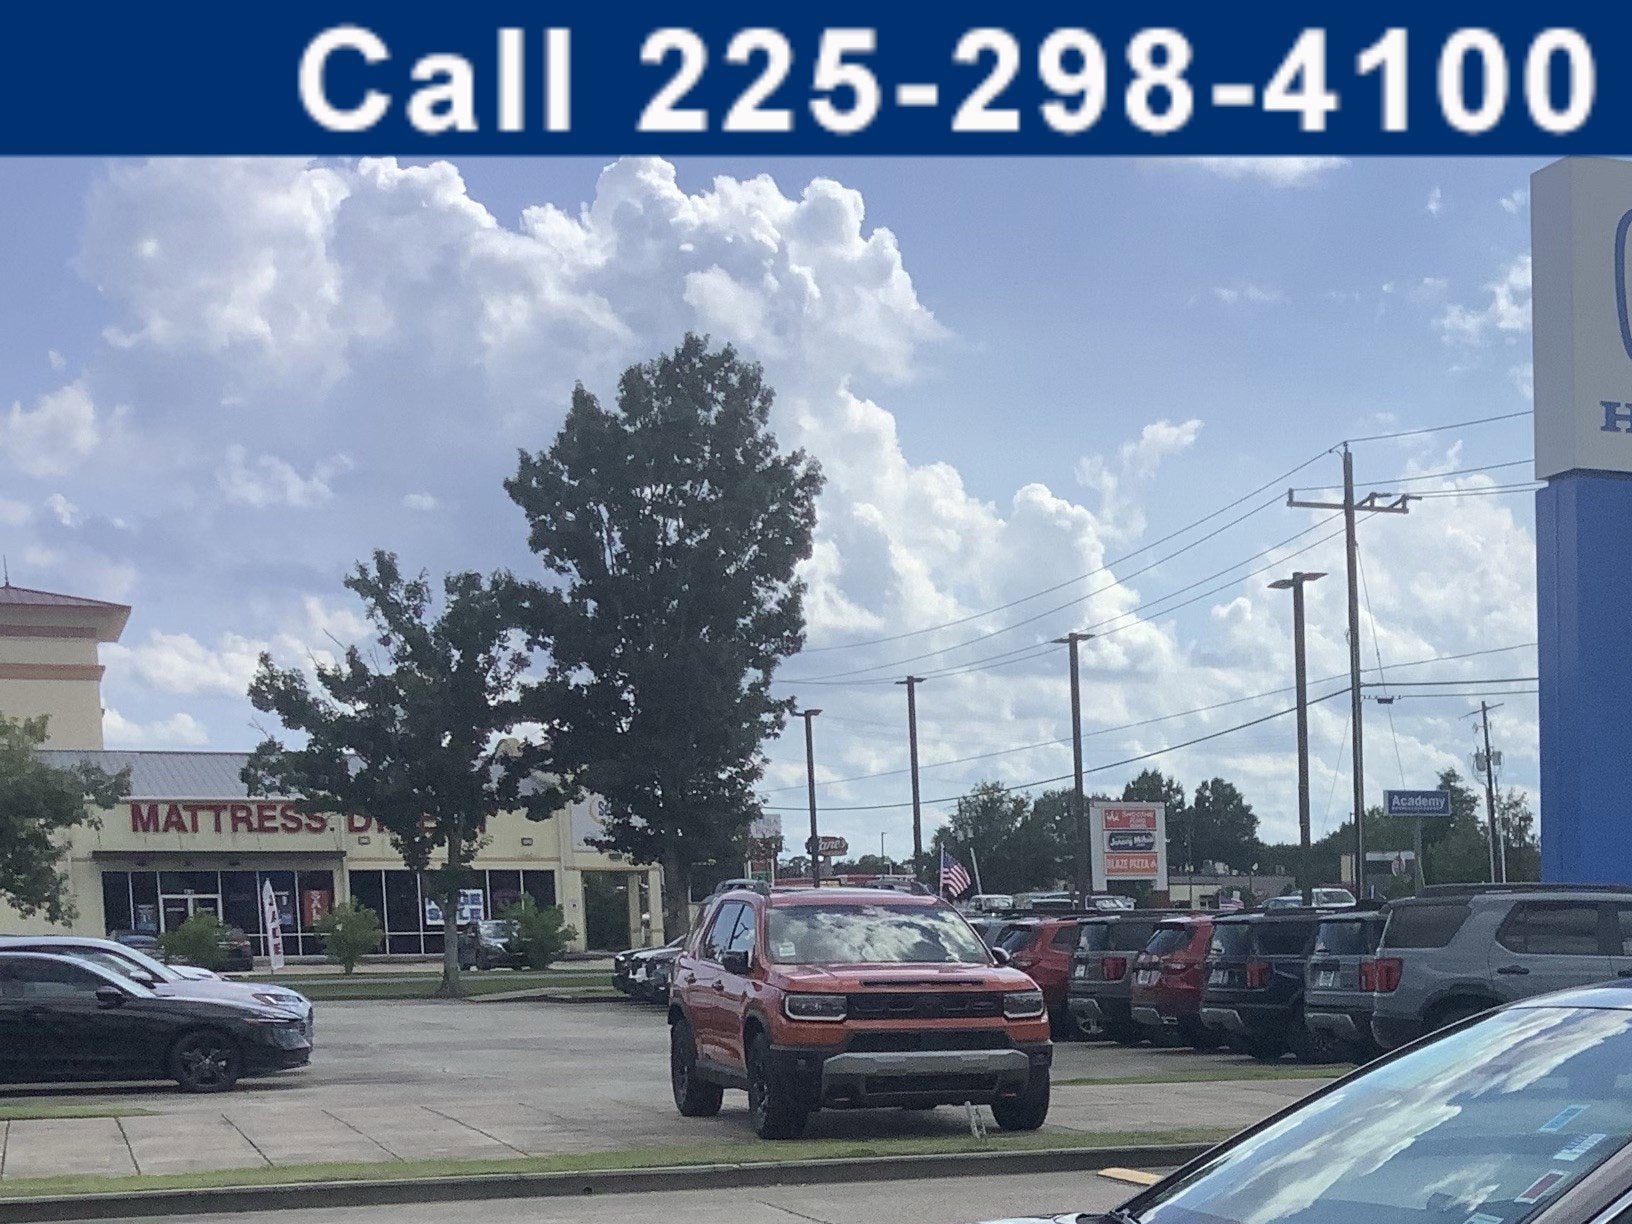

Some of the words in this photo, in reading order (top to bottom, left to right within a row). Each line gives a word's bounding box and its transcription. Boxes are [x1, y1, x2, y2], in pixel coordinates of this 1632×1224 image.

[1391, 794, 1446, 809] Academy
[130, 802, 327, 834] MATTRESS
[427, 907, 482, 921] SLE
